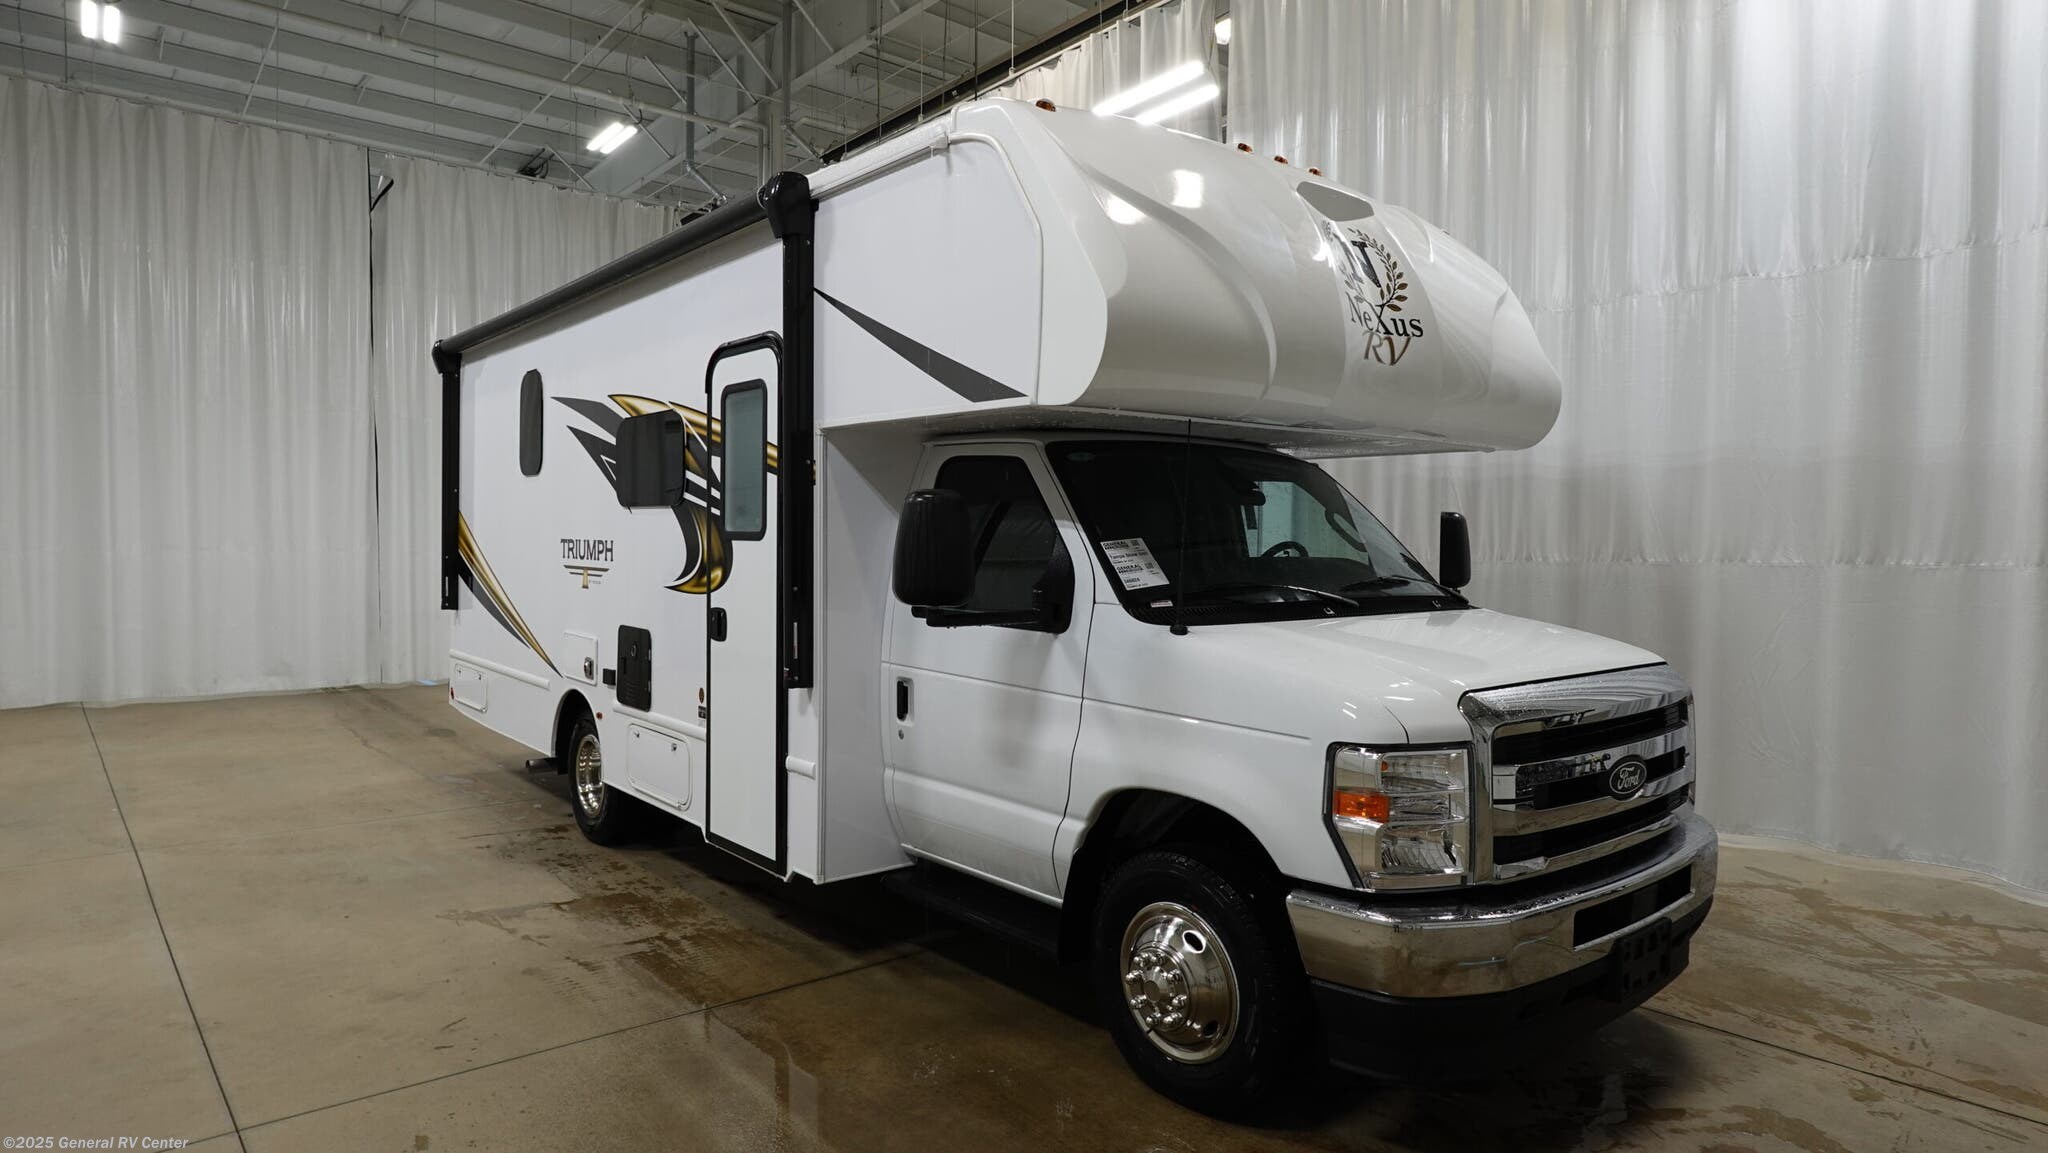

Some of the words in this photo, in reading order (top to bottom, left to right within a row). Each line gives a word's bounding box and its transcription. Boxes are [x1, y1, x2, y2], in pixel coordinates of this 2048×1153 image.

[1345, 291, 1424, 338] NeXus
[1362, 330, 1412, 367] RV
[560, 538, 614, 562] TRIUMPH
[1617, 766, 1641, 790] Ford
